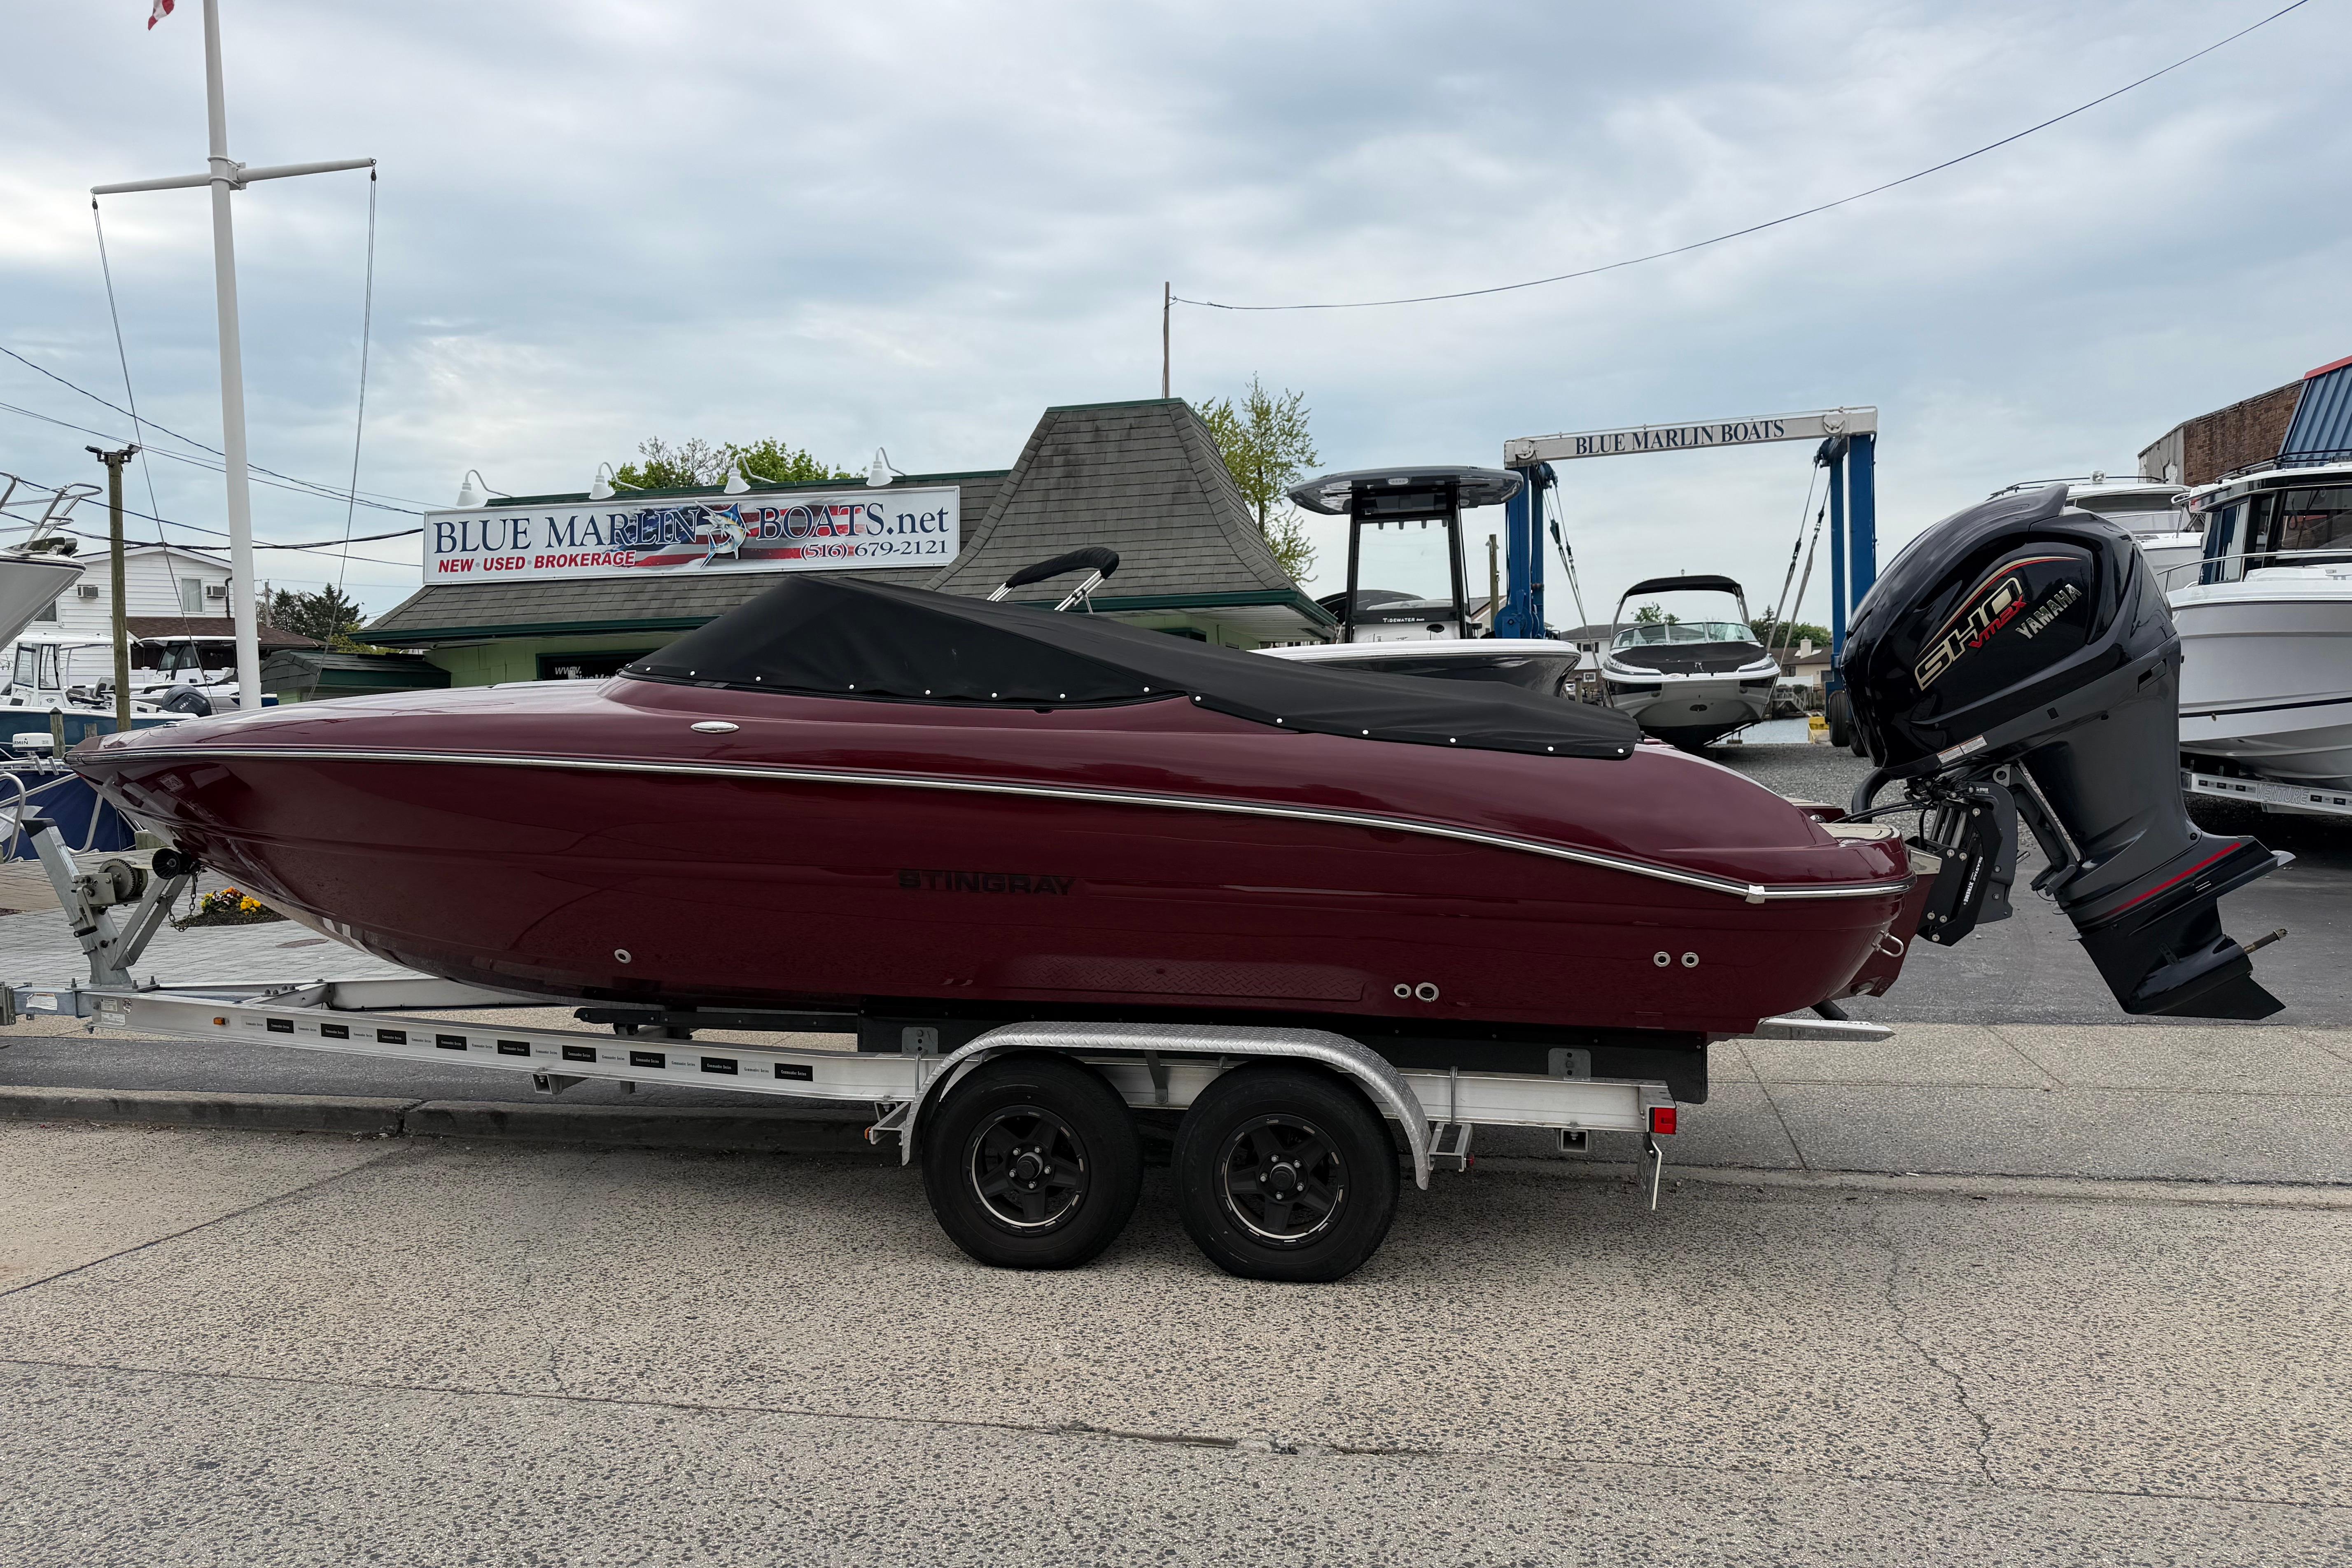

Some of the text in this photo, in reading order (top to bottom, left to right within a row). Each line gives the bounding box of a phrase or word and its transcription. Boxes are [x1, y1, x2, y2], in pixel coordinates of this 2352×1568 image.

[1576, 420, 1785, 454] BLUE MARLIN BOATS
[433, 503, 949, 554] BLUE MARLIN BOATS.net
[438, 551, 636, 573] NEW USED BROKERAGE
[800, 540, 947, 560] (516) 679-2121
[2016, 583, 2082, 639] YAMAHA
[1915, 577, 2023, 691] SHO
[2256, 784, 2310, 805] VENTURE
[899, 870, 1076, 896] STINGRAY
